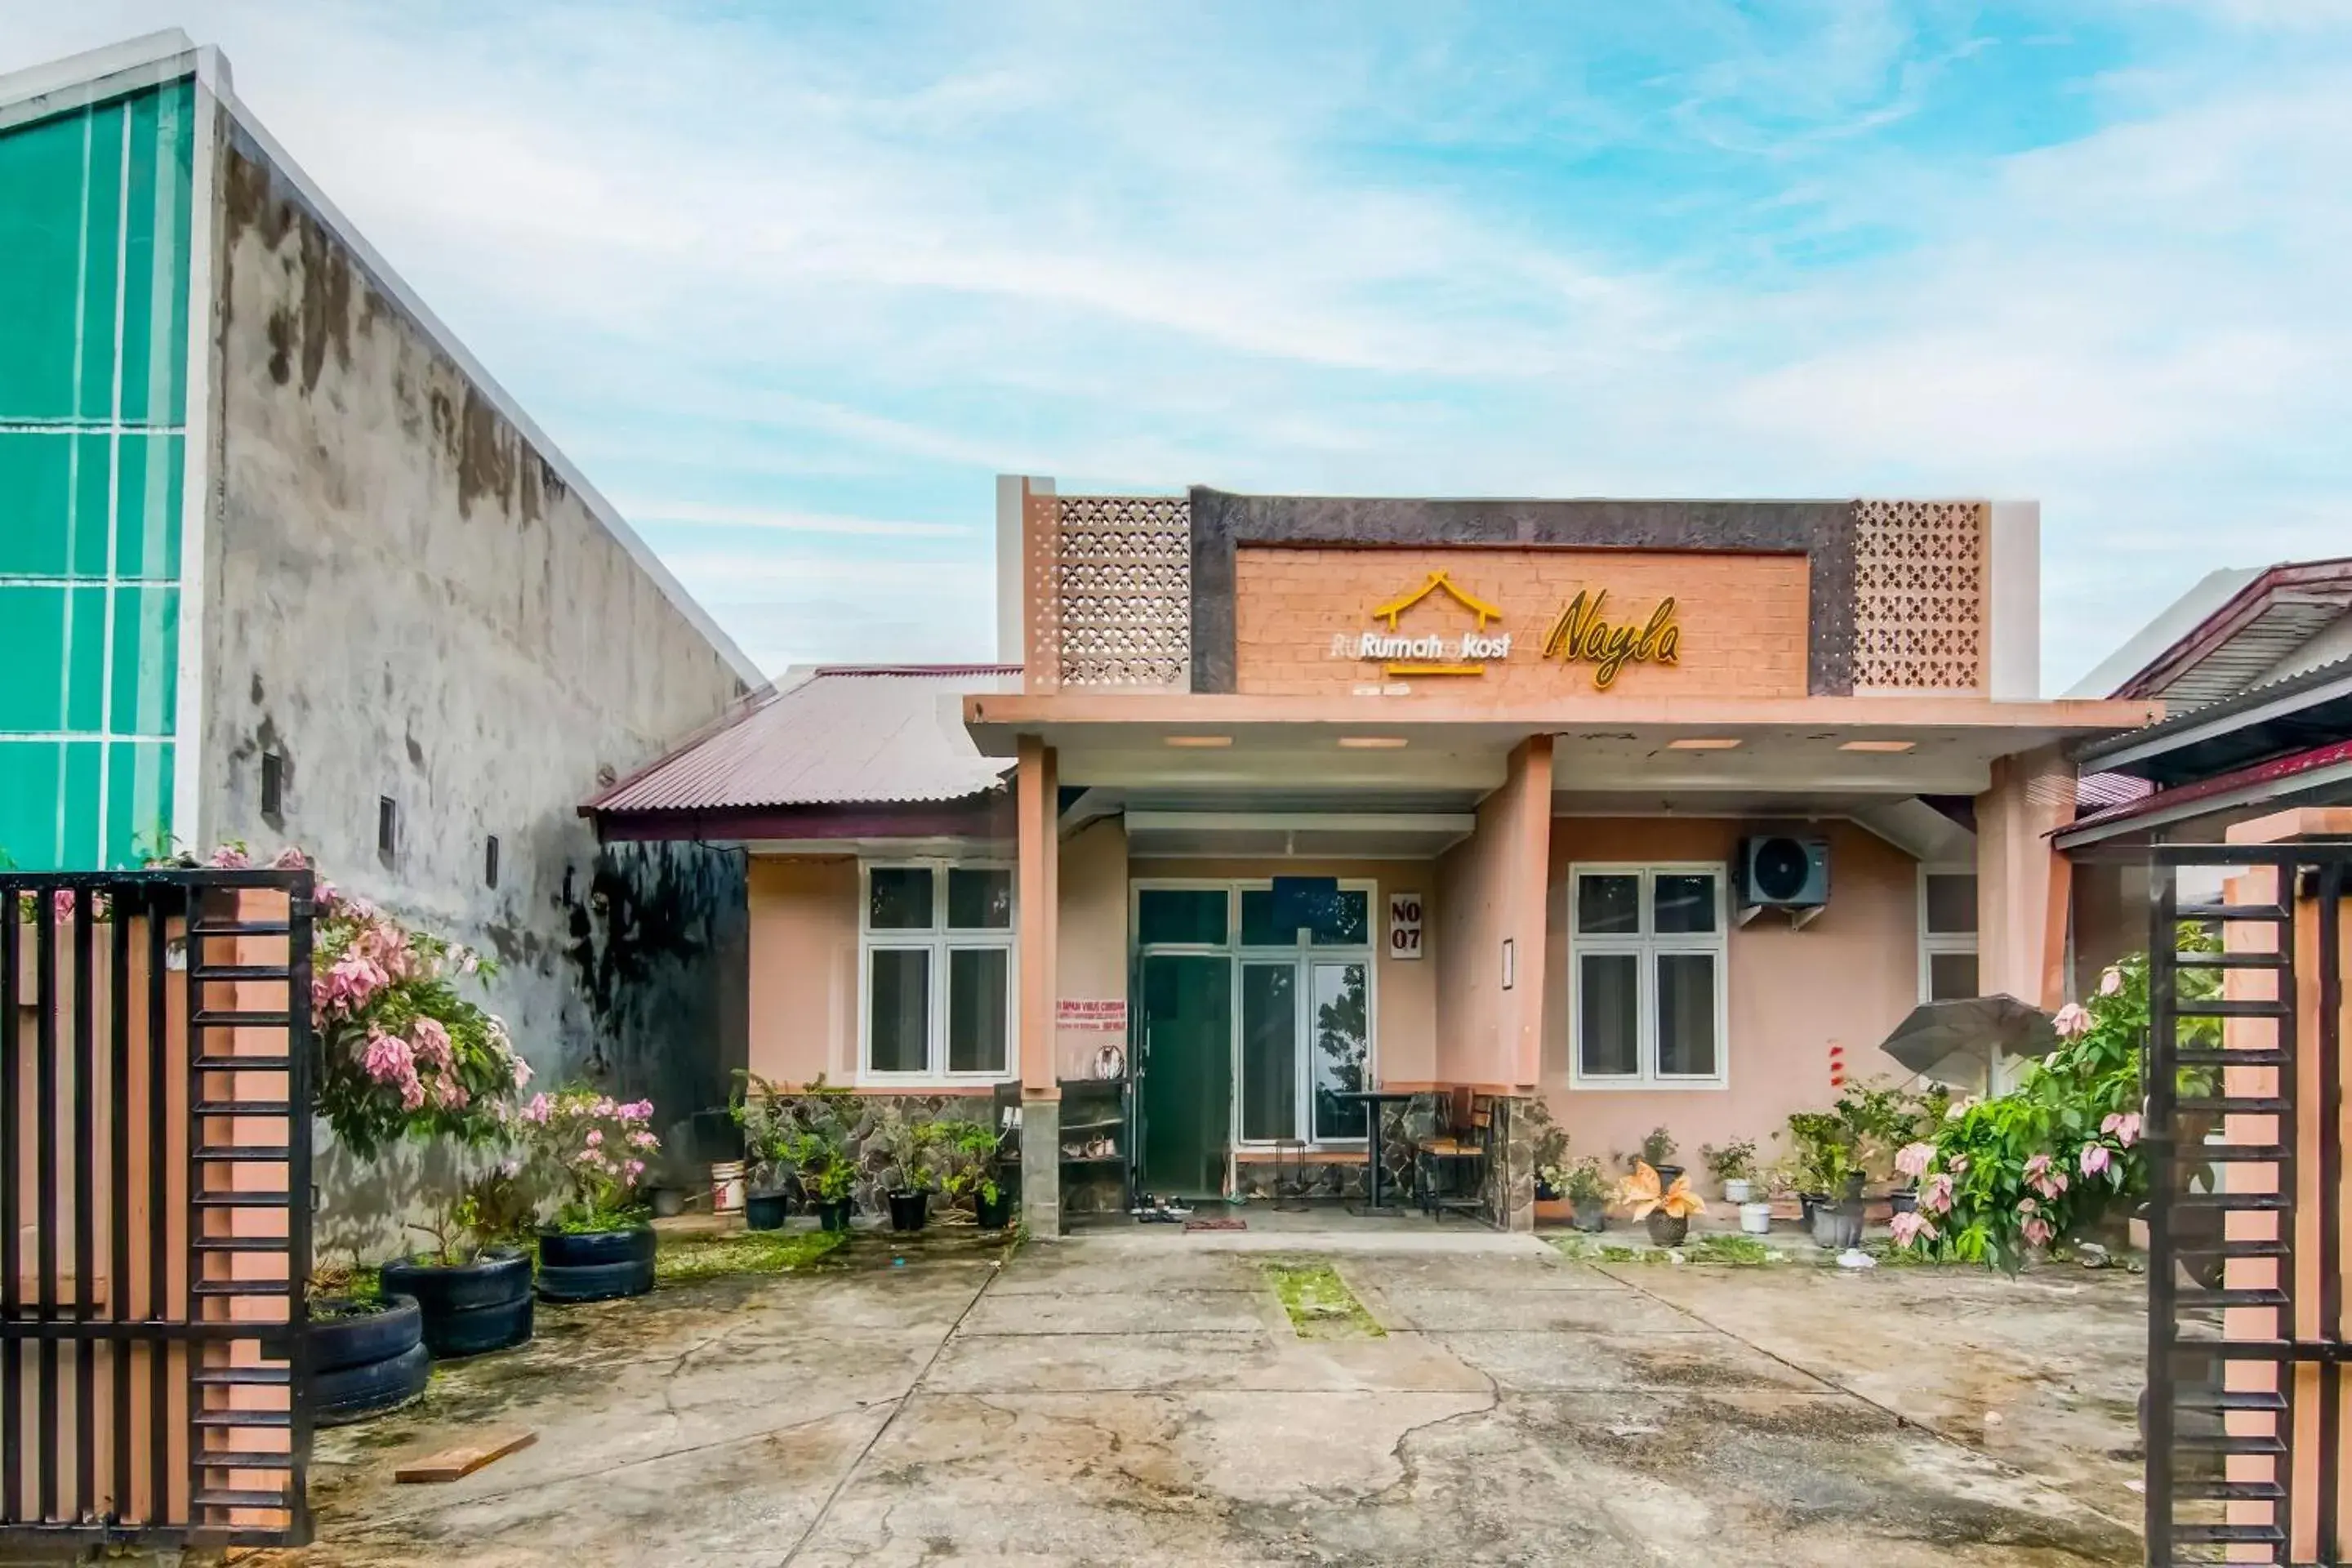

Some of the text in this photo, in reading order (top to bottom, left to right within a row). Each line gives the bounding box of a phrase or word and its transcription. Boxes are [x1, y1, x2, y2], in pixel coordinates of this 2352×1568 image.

[1361, 631, 1442, 659] Rumah
[1543, 587, 1681, 690] Nayla
[1392, 901, 1420, 922] NO
[1392, 929, 1420, 949] 07
